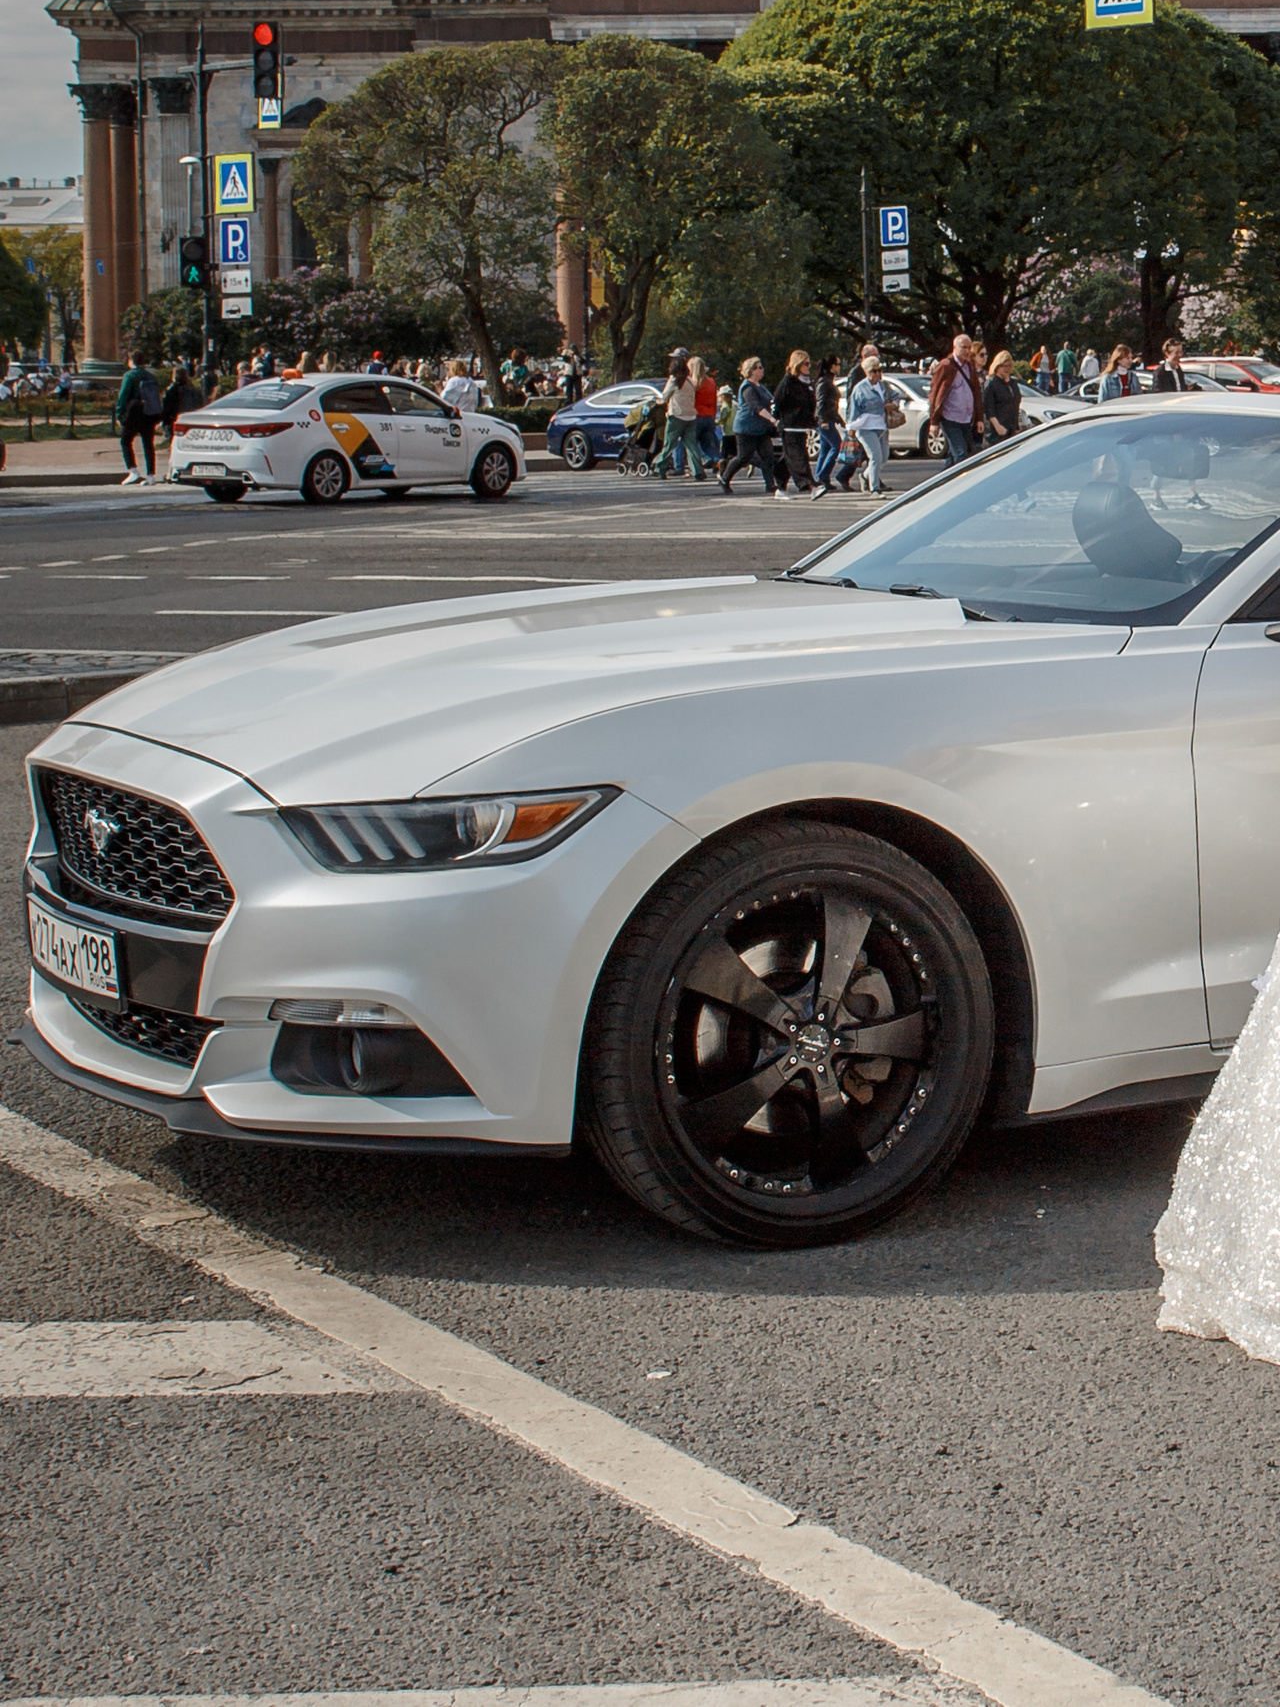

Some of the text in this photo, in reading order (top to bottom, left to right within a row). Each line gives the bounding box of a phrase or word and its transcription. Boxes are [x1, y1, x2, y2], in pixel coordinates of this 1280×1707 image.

[888, 211, 903, 242] P
[227, 224, 244, 260] P
[379, 422, 393, 432] 381
[424, 424, 449, 435] Яндекс
[442, 437, 461, 448] Такси
[81, 933, 112, 976] 198
[89, 972, 106, 990] RUS
